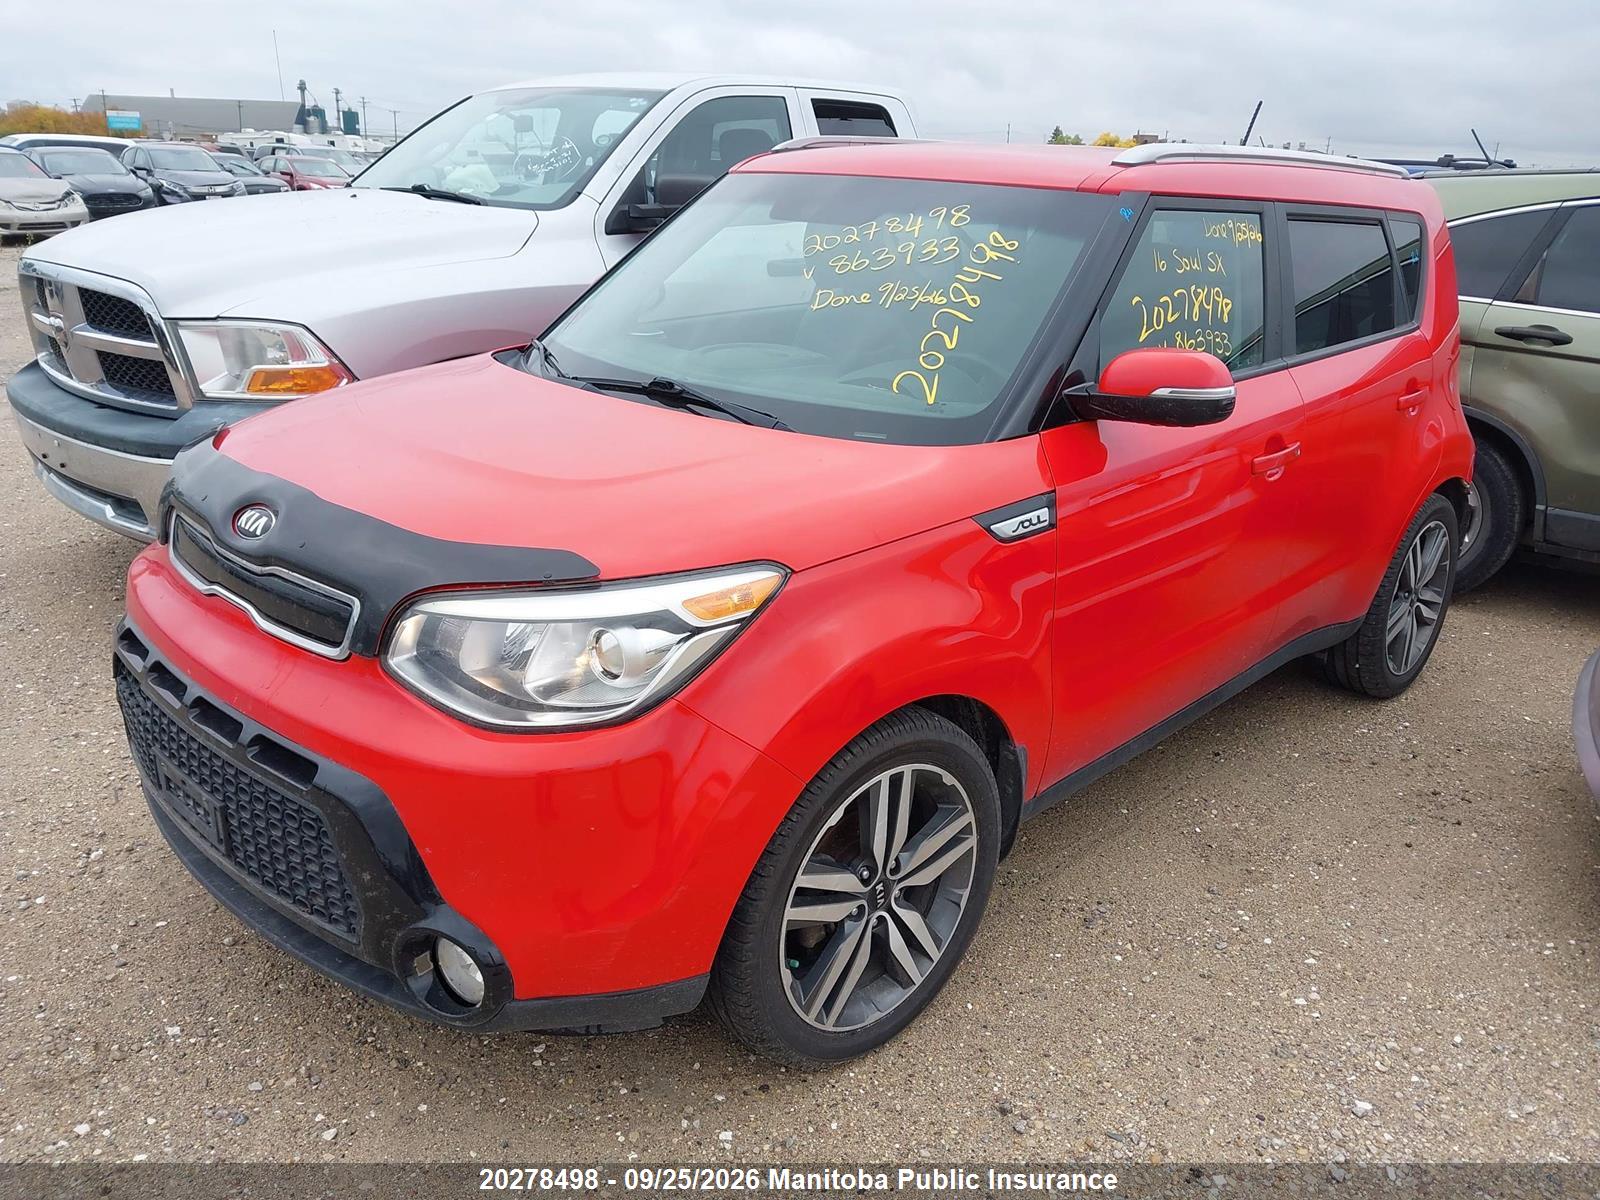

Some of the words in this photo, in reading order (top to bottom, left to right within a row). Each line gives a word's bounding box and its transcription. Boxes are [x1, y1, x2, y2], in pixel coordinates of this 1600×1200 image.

[804, 204, 971, 258] 20278498
[828, 236, 961, 275] 863933
[1153, 249, 1168, 273] 16
[1172, 248, 1203, 274] Soul
[1207, 251, 1228, 277] SX
[811, 289, 873, 311] Done
[1131, 284, 1233, 343] 20278498
[891, 231, 1019, 405] 20278498
[236, 508, 270, 537] KIA
[875, 881, 886, 909] KIA
